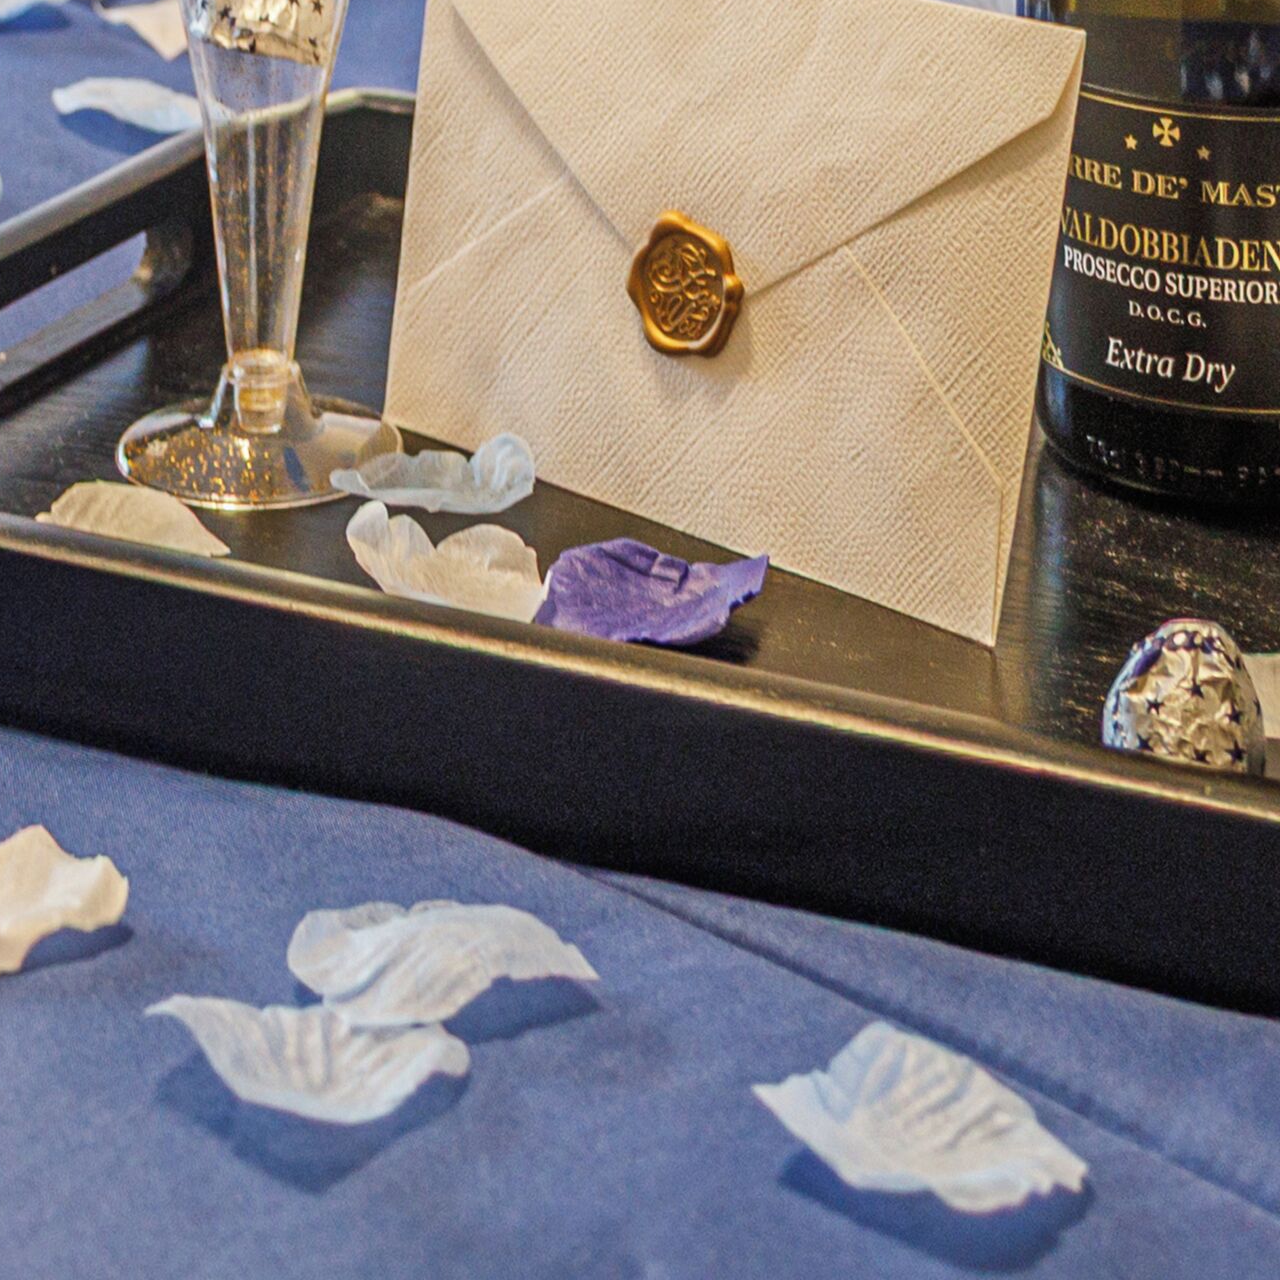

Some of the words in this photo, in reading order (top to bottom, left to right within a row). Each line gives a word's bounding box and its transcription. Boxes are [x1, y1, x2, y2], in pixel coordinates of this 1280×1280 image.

[1069, 154, 1122, 190] RRE
[1063, 244, 1161, 293] PROSECCO
[1105, 336, 1175, 378] Extra
[1182, 352, 1236, 393] Dry
